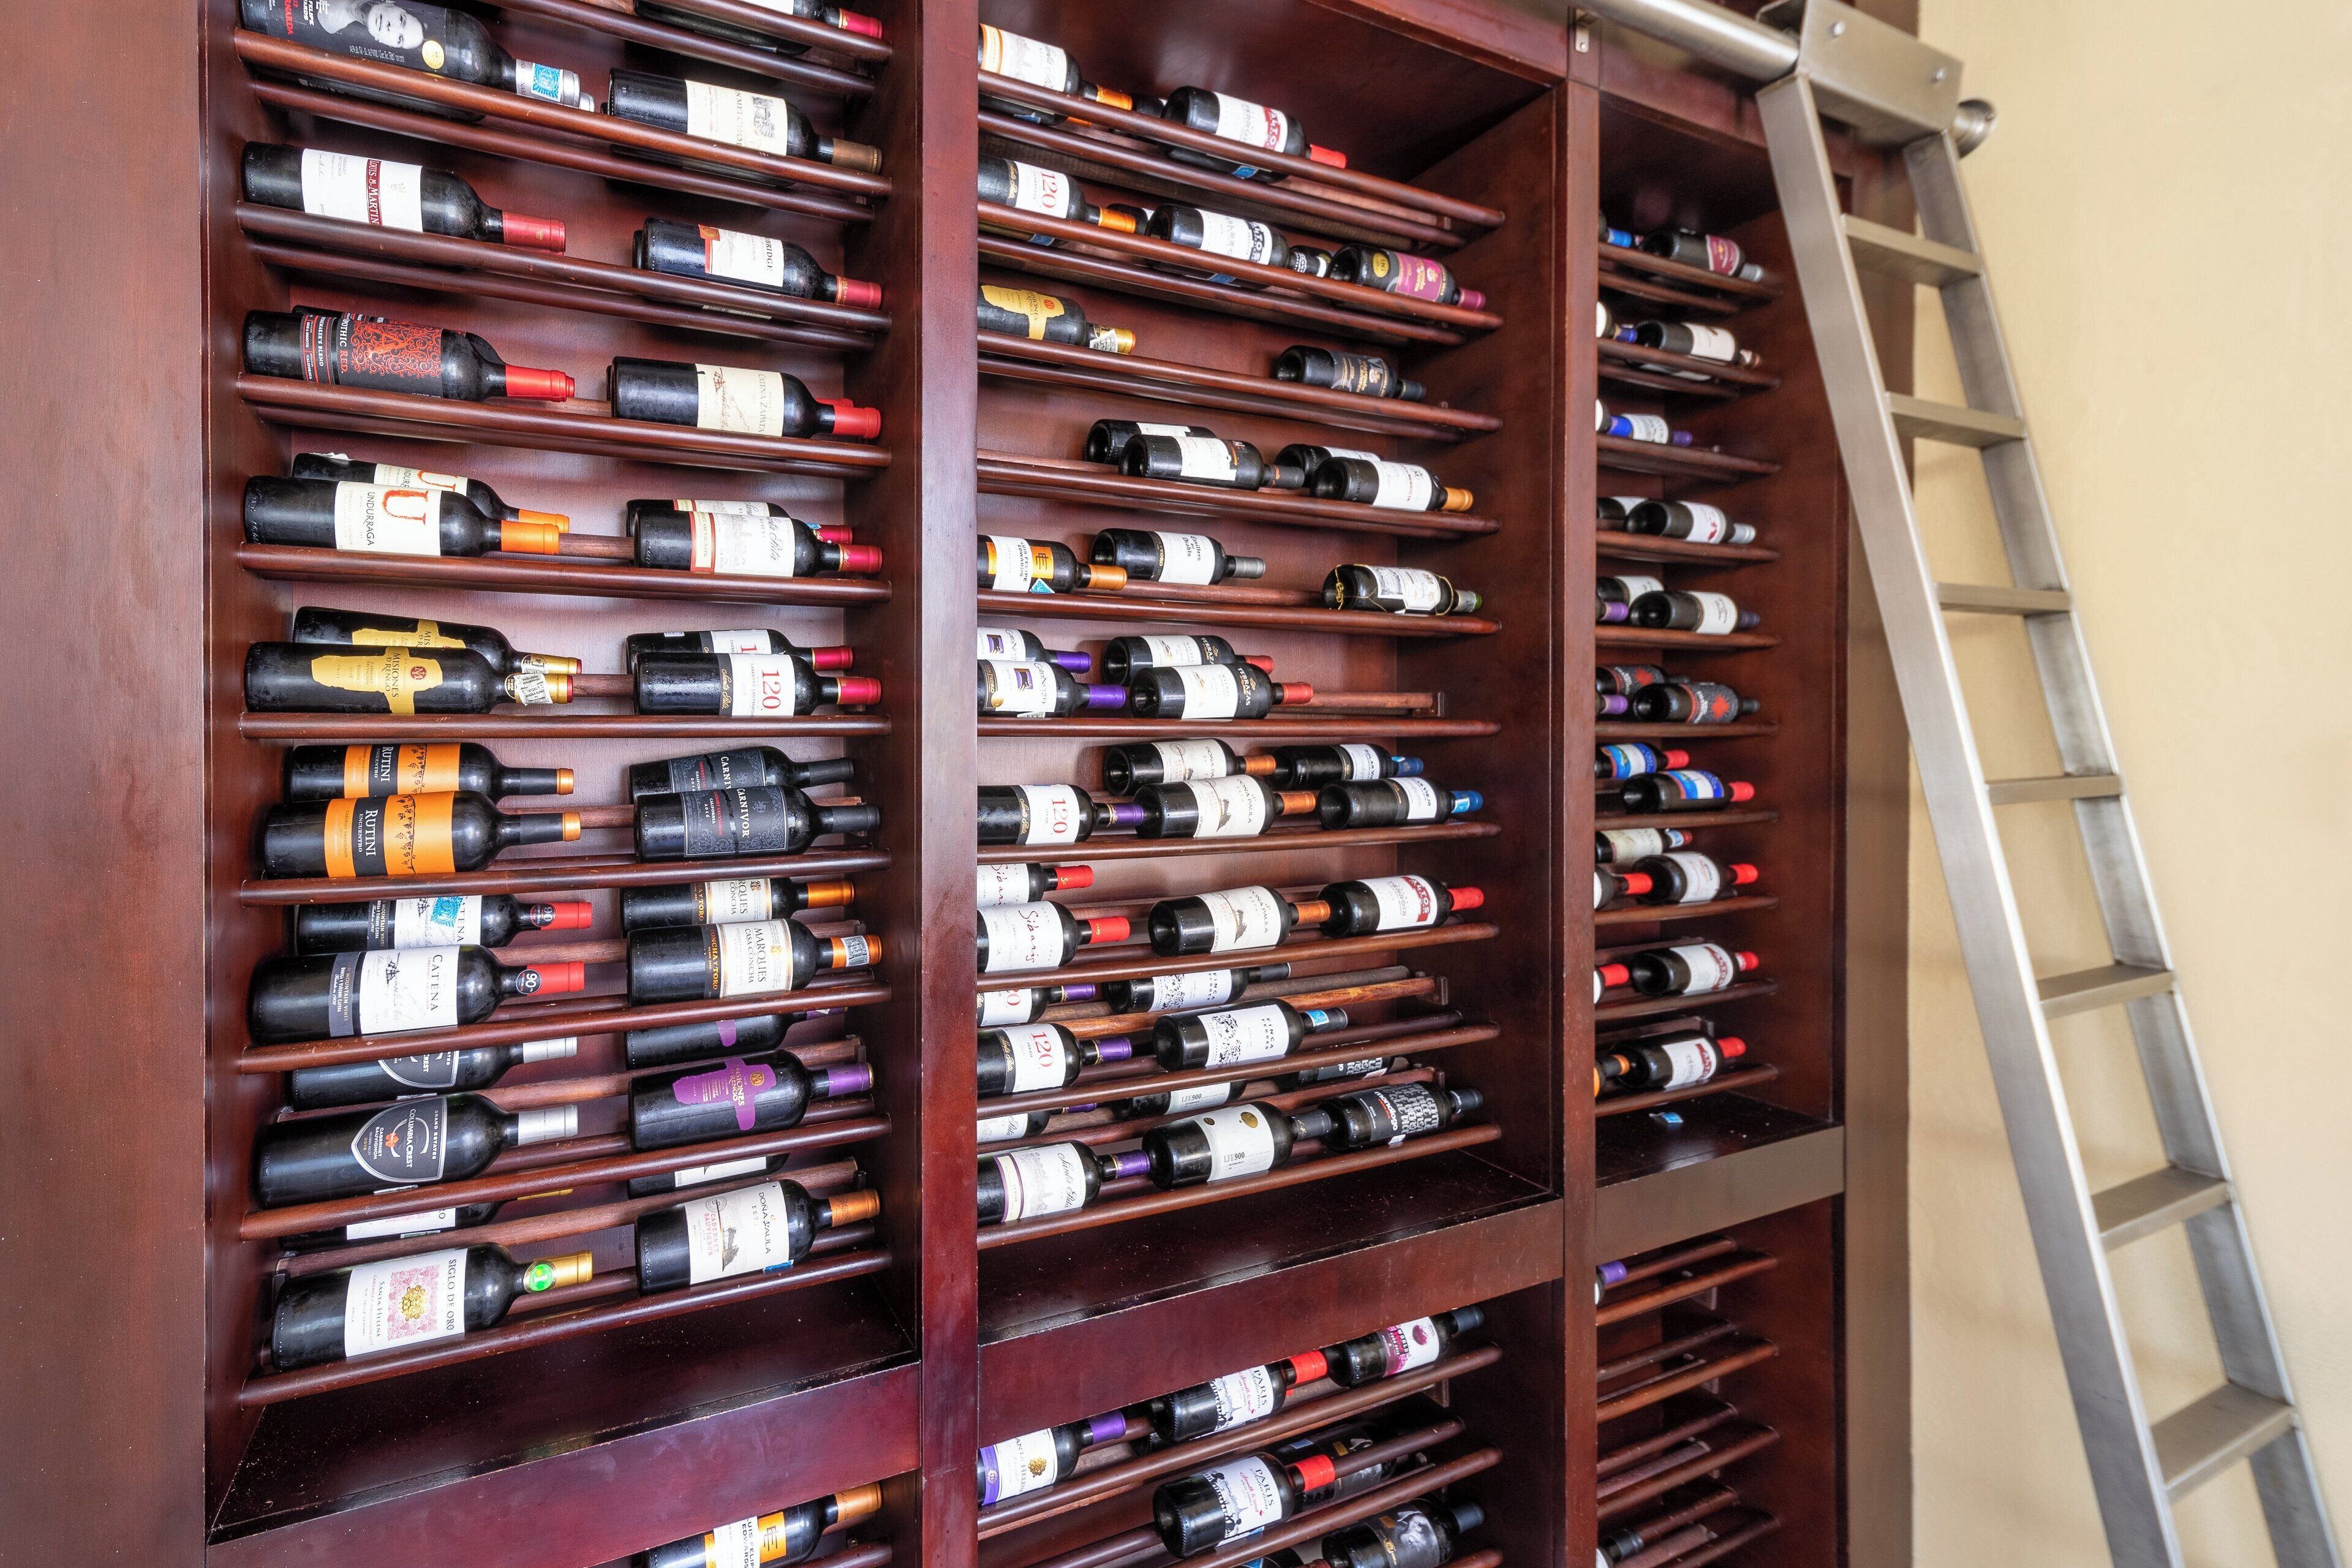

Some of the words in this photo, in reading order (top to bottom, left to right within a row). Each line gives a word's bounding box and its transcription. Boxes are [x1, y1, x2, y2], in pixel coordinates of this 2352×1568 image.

[369, 160, 379, 176] LOUIS
[369, 186, 379, 225] MARTIN
[1041, 172, 1057, 208] 120
[758, 374, 767, 399] CATENA
[758, 402, 767, 432] ZAPATA
[363, 492, 375, 546] UNDURRAGA
[1201, 638, 1214, 664] TERRAZ
[382, 663, 391, 692] RENGO
[392, 653, 401, 698] MISIONES
[722, 669, 732, 691] Santa
[761, 669, 781, 709] 120
[1237, 667, 1251, 706] TERRAZAS
[380, 747, 393, 782] RUTINI
[721, 756, 731, 790] CARNIV
[737, 788, 750, 837] CARNIVOR
[1051, 799, 1068, 834] 120
[365, 810, 378, 856] RUTINI
[738, 880, 748, 914] RQUES
[745, 929, 753, 944] CASA
[1018, 910, 1039, 962] Sibaris
[753, 928, 766, 982] MARQUES
[430, 954, 443, 1011] CATENA
[526, 973, 537, 988] 90
[1006, 989, 1021, 1006] 20
[1030, 1031, 1054, 1067] 120
[1266, 1018, 1275, 1049] FINCA
[729, 1075, 738, 1102] RENGO
[1058, 1153, 1075, 1184] Santa
[759, 1192, 768, 1219] DOÑA
[1064, 1187, 1077, 1208] Rita
[704, 1213, 713, 1256] SAUVIGNON
[763, 1221, 771, 1254] PAULA
[447, 1259, 457, 1289] SIGLO
[377, 1281, 385, 1305] SANTA
[447, 1294, 455, 1306] DE
[446, 1311, 454, 1330] ORO
[1253, 1370, 1267, 1406] PARIS
[1016, 1437, 1024, 1461] ANTA
[1255, 1469, 1274, 1506] PARIS
